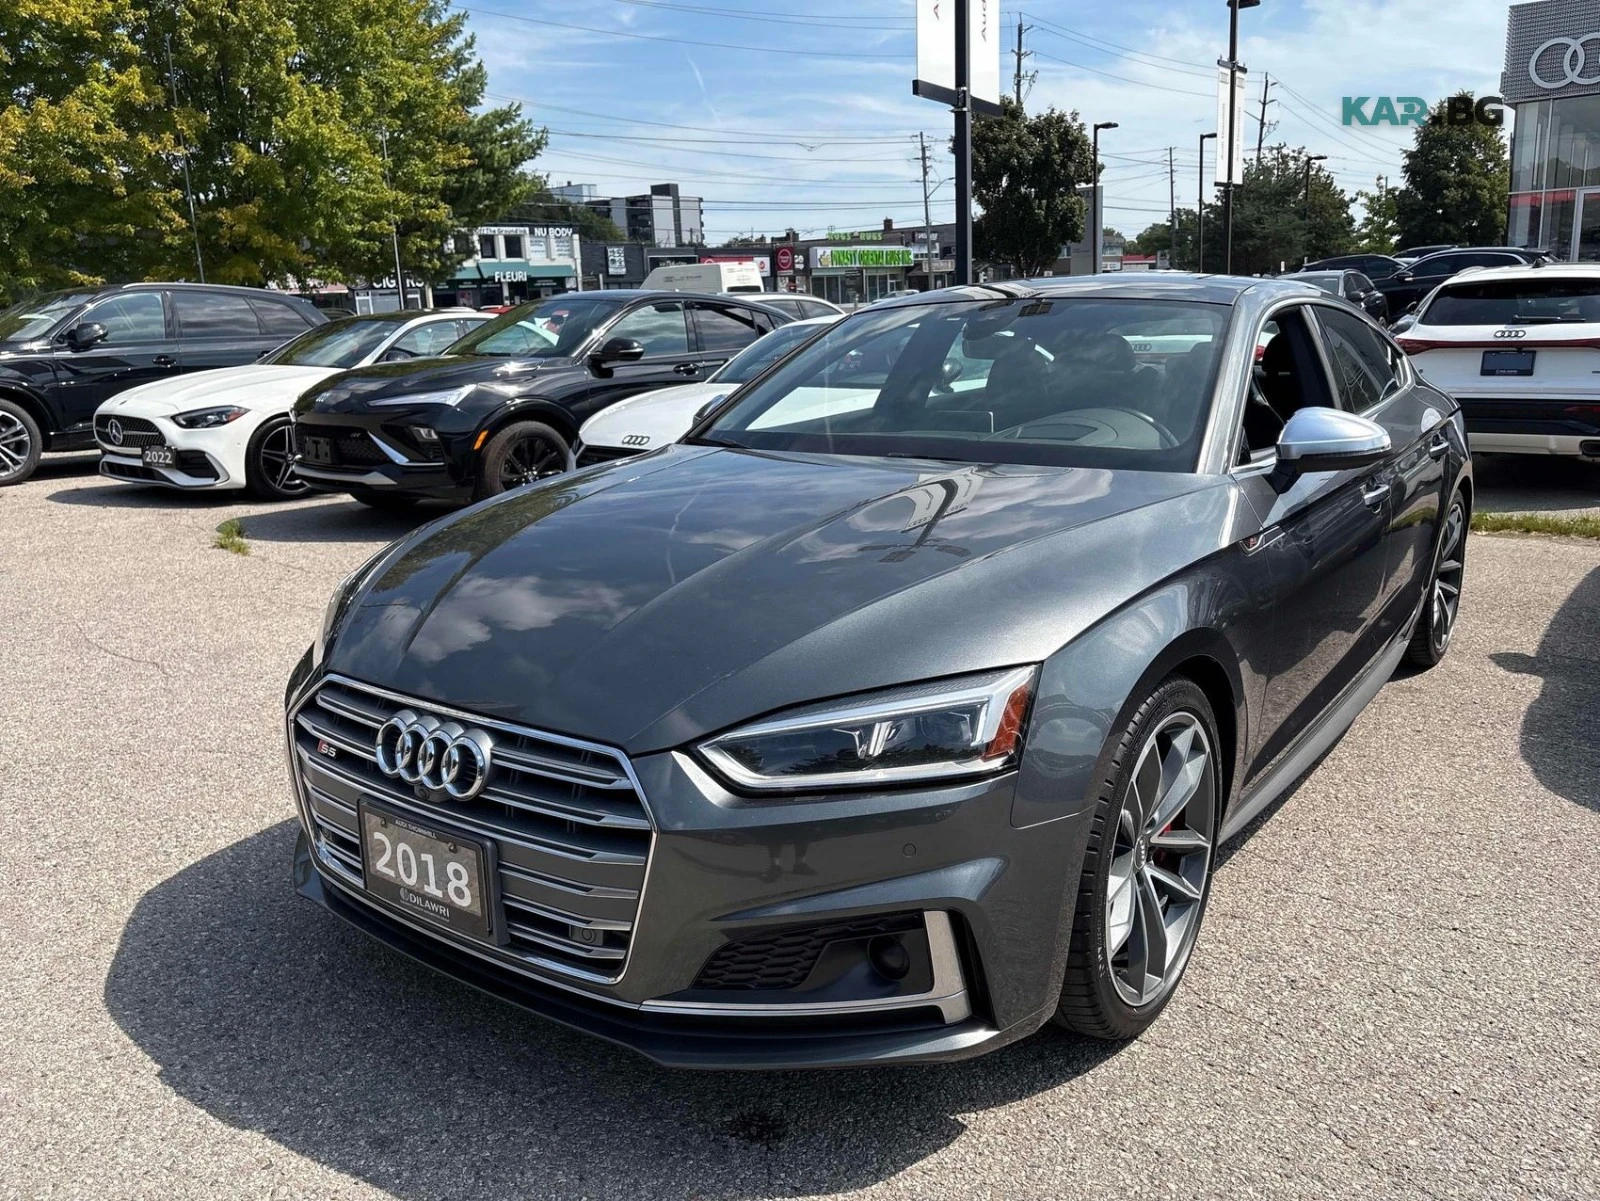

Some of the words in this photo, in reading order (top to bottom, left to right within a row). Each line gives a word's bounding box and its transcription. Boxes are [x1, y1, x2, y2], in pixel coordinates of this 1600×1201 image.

[534, 227, 547, 237] NU
[548, 227, 573, 237] BODY
[860, 232, 883, 240] RUGS
[859, 249, 885, 266] ORIENTAL
[494, 271, 528, 282] FLEURI
[145, 450, 173, 464] 2022
[320, 743, 337, 758] S5
[373, 831, 472, 907] 2018
[409, 893, 450, 917] DILAWRI
